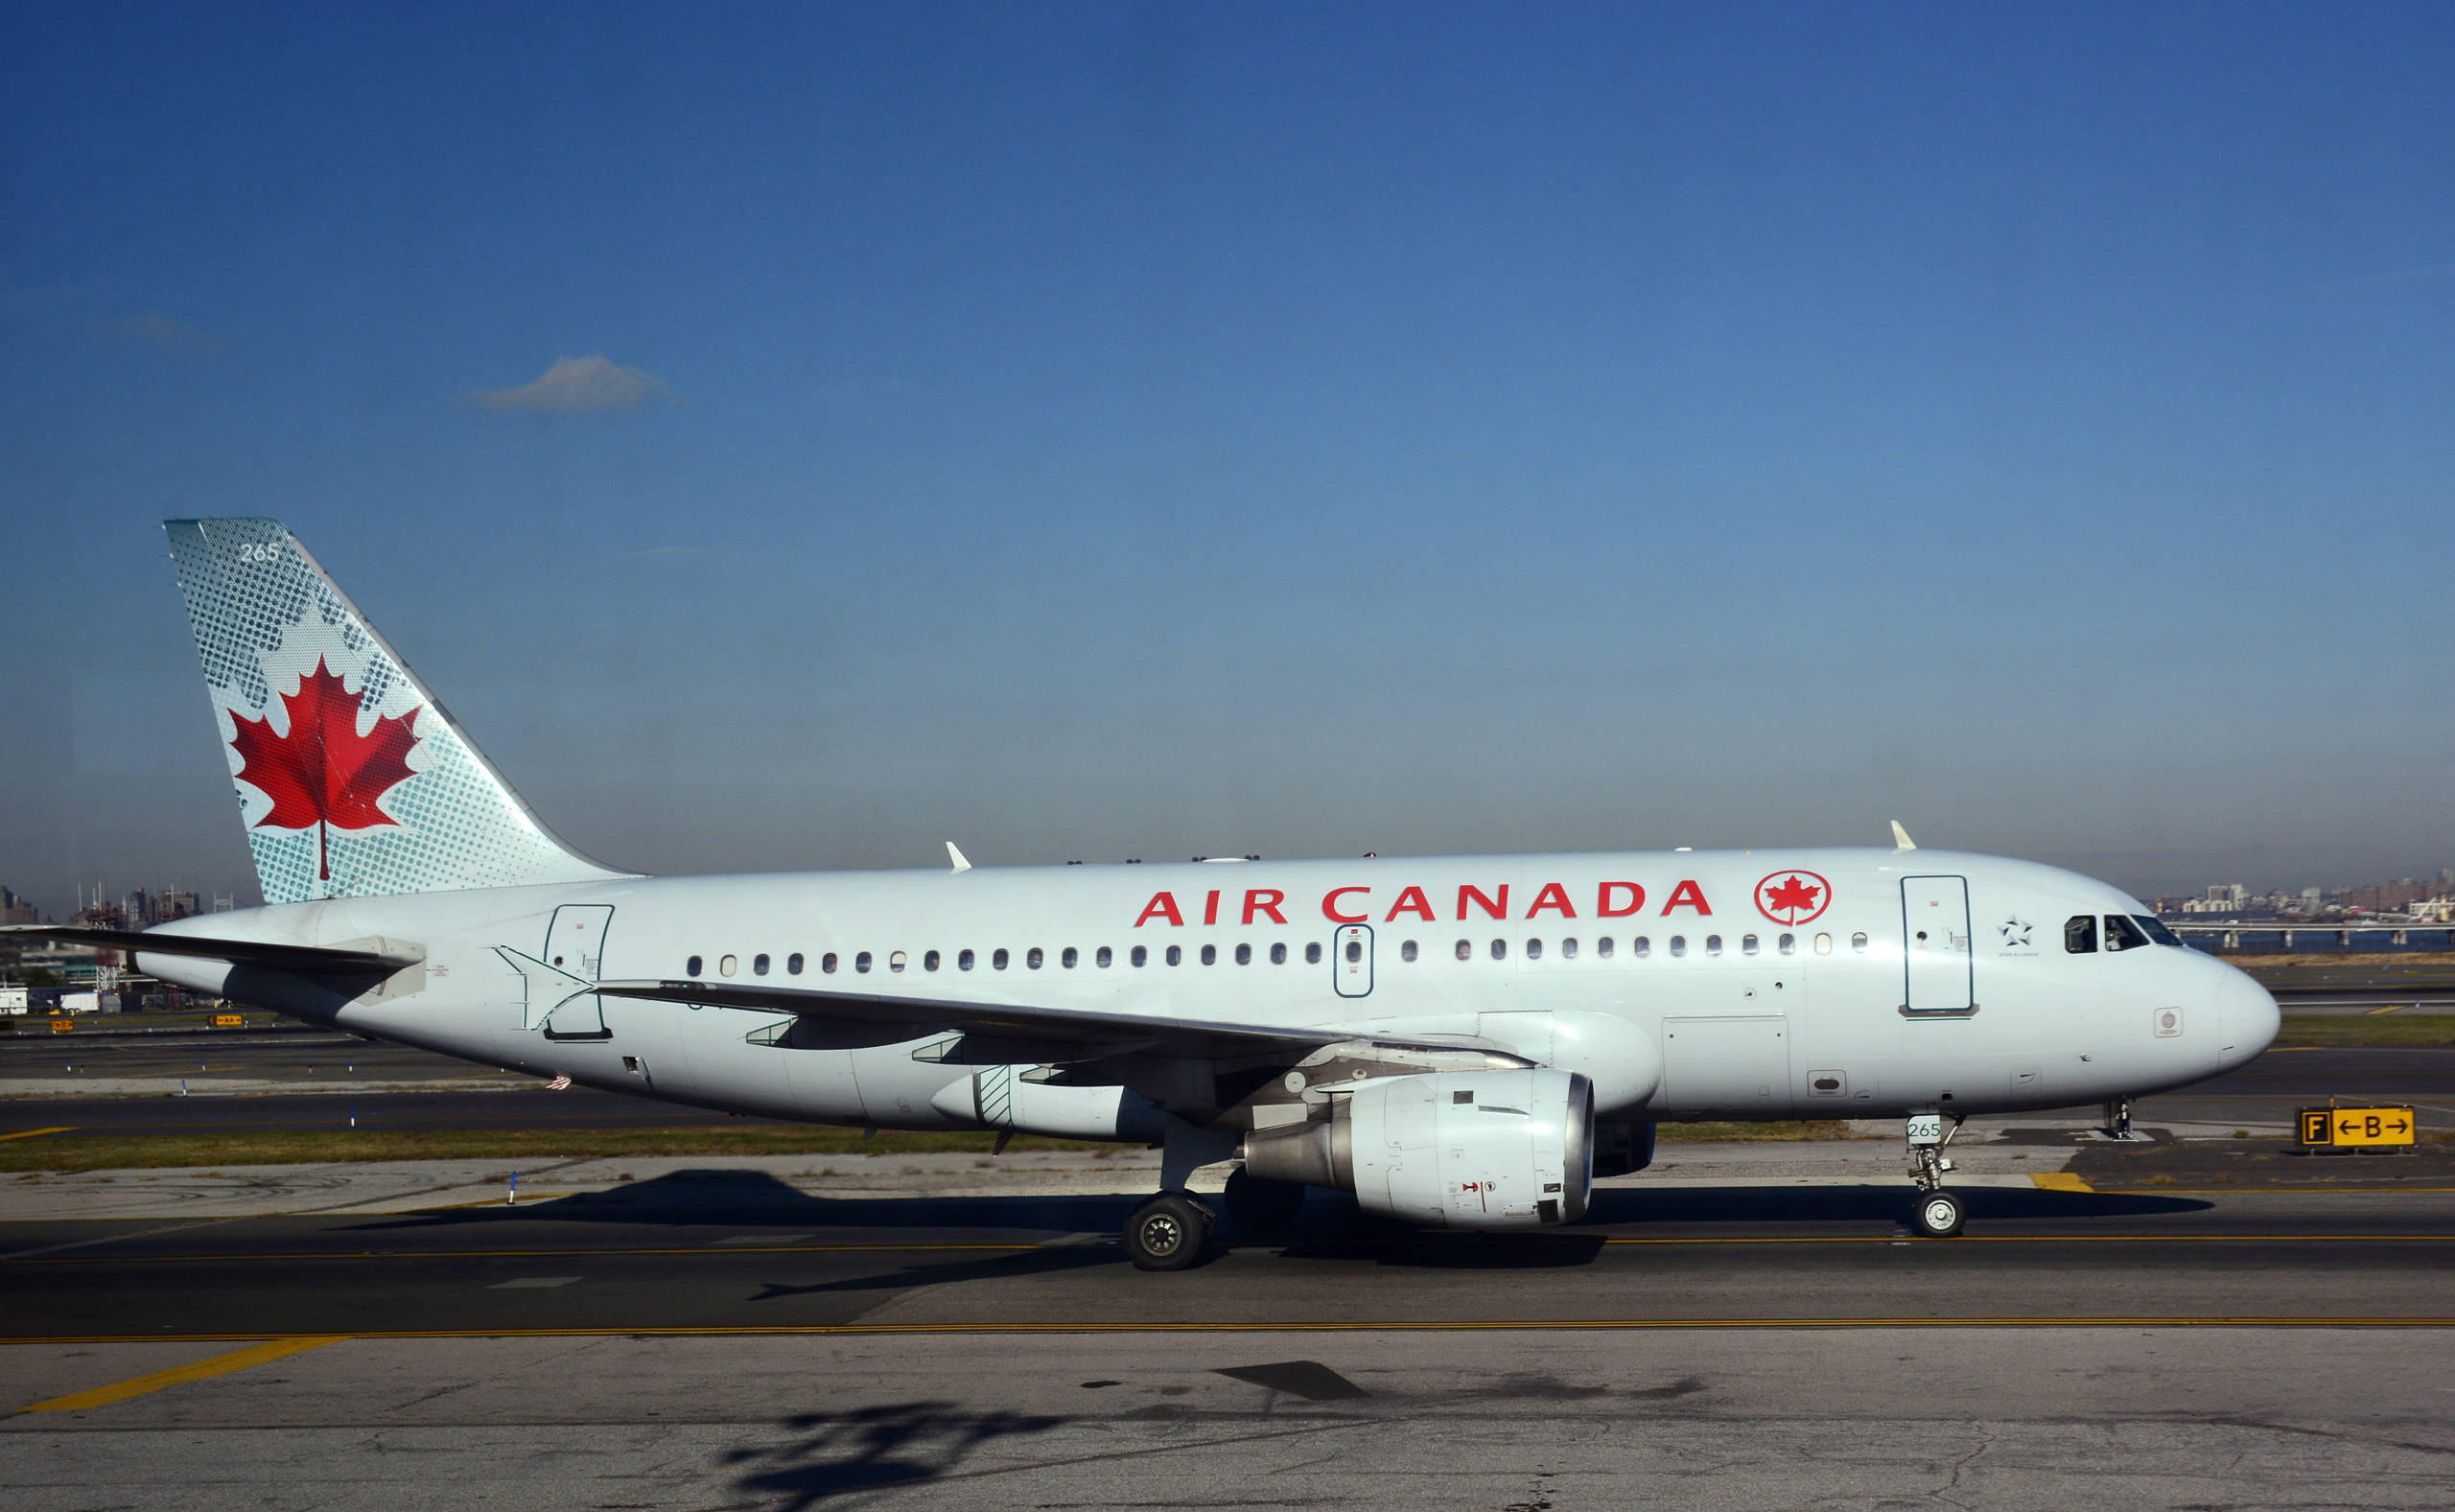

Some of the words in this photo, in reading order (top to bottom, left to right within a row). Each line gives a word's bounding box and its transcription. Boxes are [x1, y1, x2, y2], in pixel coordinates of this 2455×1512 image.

[241, 544, 280, 562] 265
[1134, 890, 1288, 927] AIR
[1321, 879, 1713, 924] CANADA
[1908, 1124, 1941, 1137] 265
[2308, 1116, 2324, 1140] F
[2365, 1116, 2381, 1138] B
